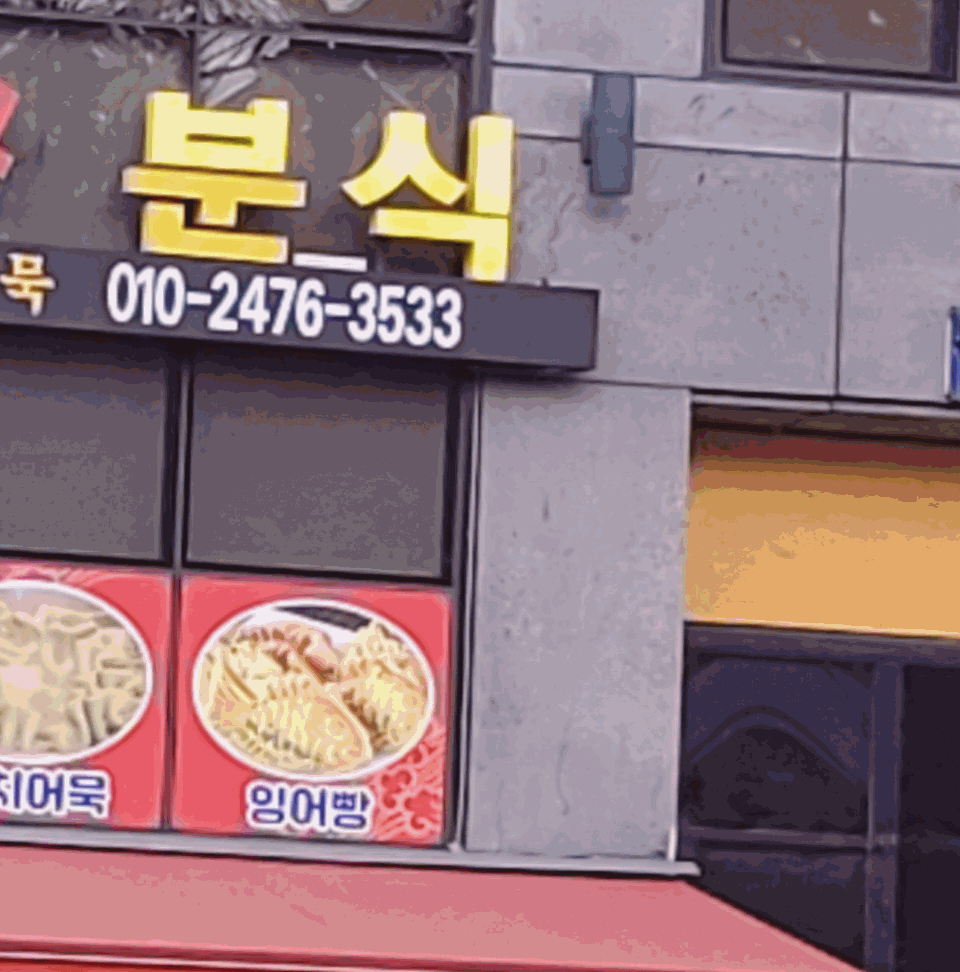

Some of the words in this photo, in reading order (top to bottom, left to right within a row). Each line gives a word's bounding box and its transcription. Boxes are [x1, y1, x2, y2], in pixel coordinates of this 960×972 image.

[122, 91, 516, 282] 분식
[106, 262, 462, 349] 010-2476-3533
[251, 784, 371, 829] 잉어빵
